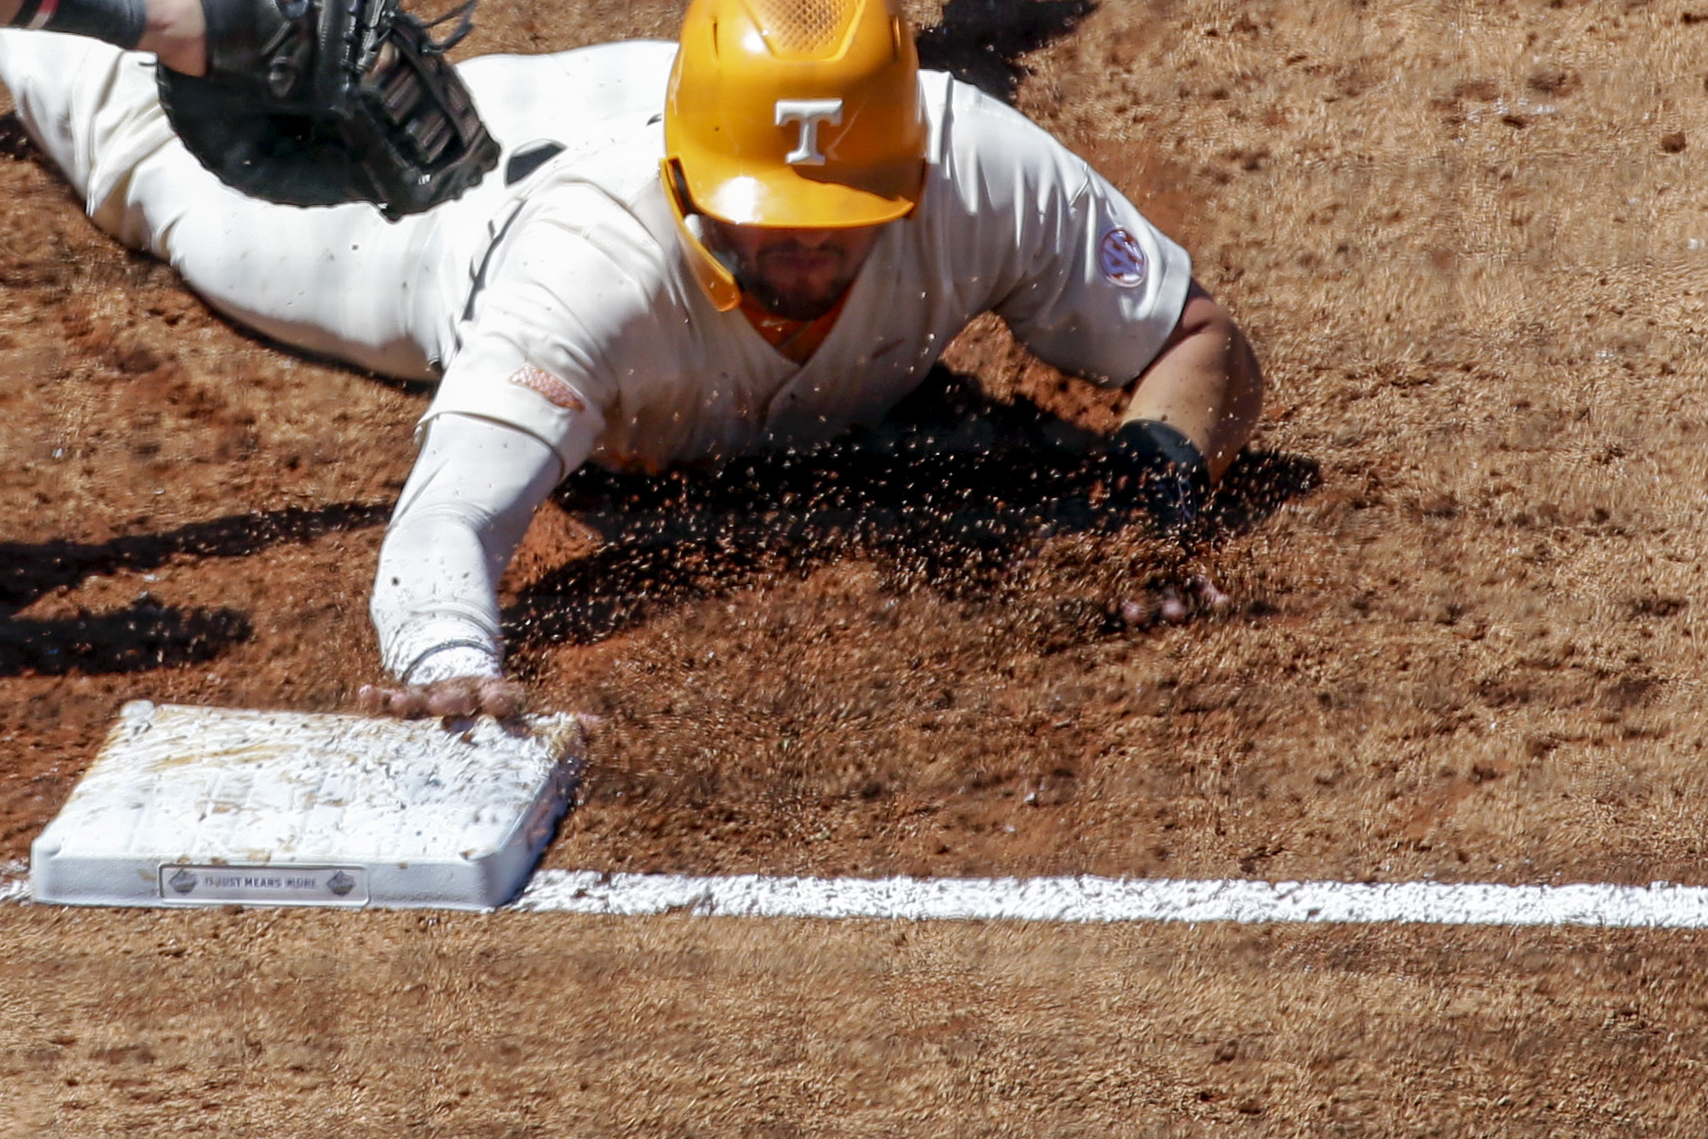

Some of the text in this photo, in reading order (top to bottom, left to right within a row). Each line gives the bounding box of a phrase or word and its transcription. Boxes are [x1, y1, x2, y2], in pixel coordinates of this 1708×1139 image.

[774, 97, 843, 166] T
[245, 876, 281, 888] MEANS
[287, 876, 317, 889] MORE
